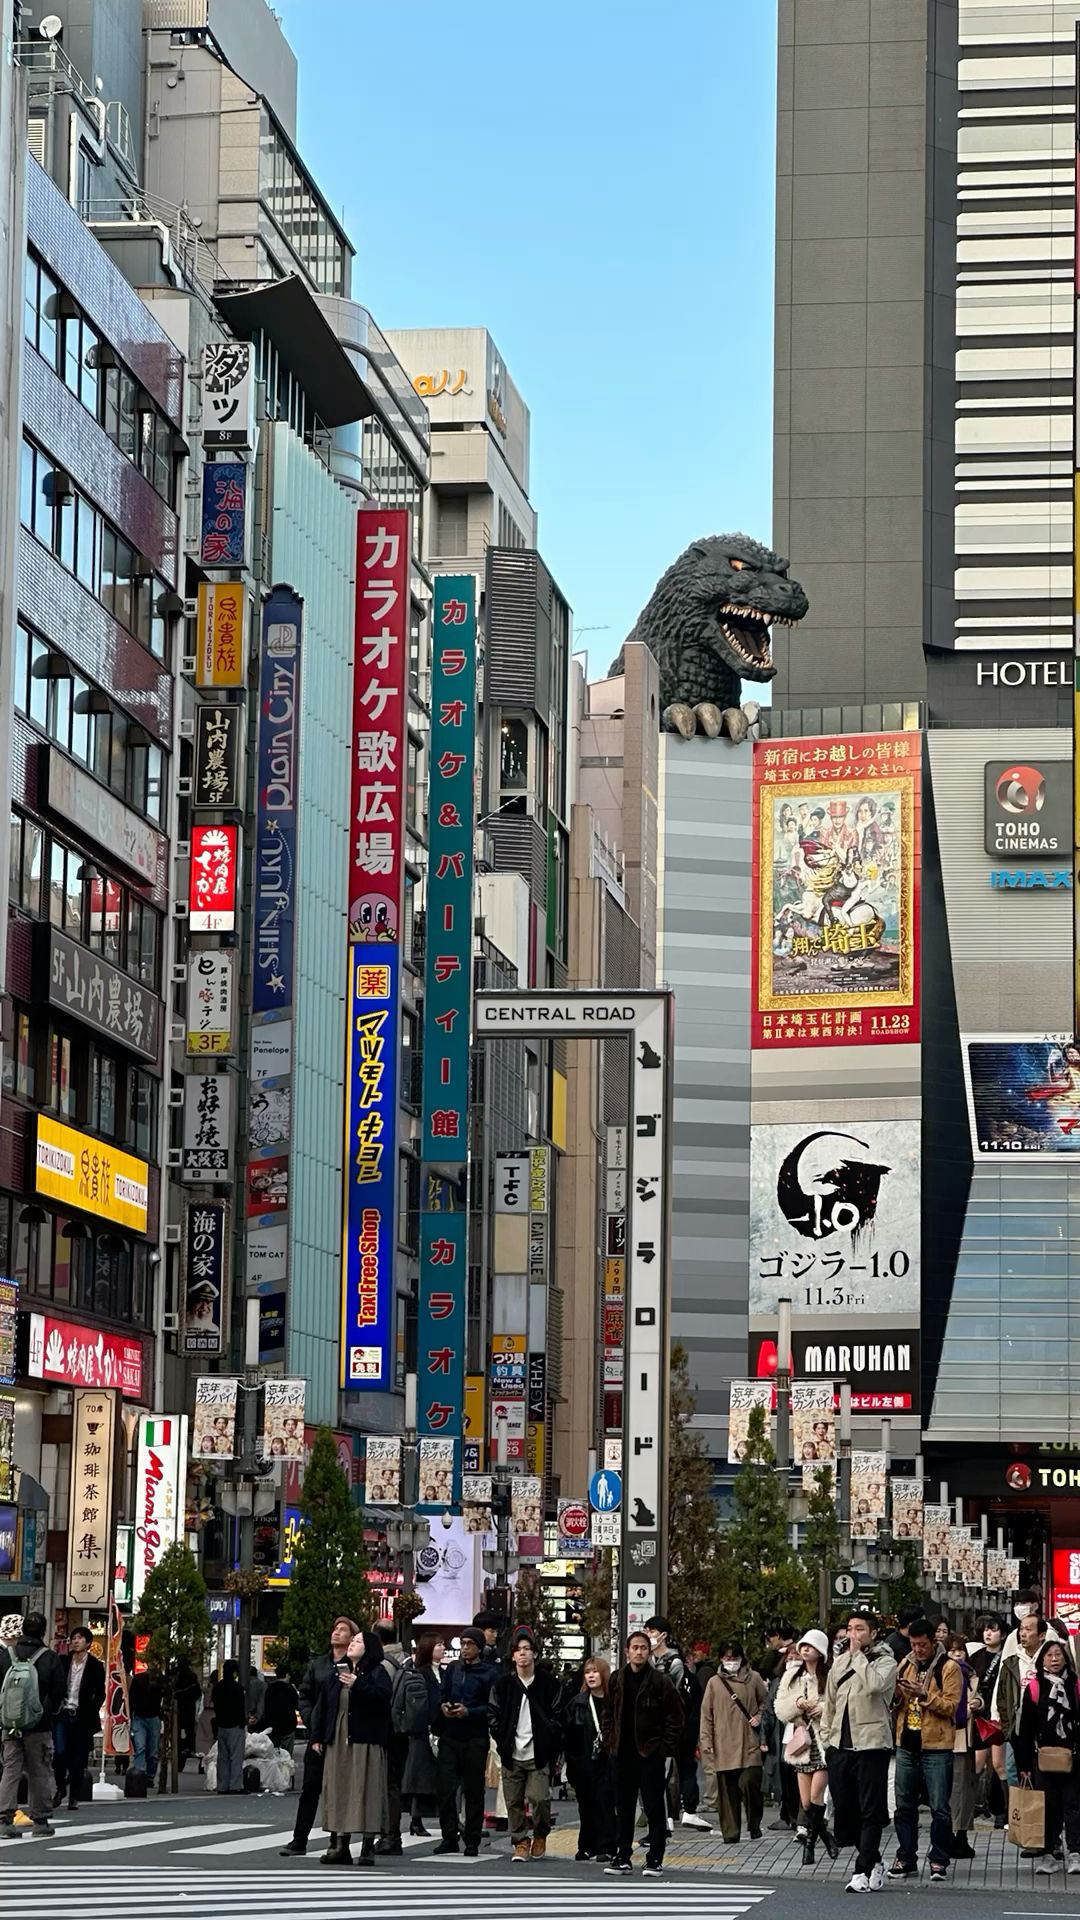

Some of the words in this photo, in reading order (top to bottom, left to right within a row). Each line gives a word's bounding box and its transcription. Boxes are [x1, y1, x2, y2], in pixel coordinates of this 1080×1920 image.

[213, 345, 240, 424] ダーツ
[203, 480, 244, 562] 海の家
[217, 597, 237, 671] 鳥貴族
[977, 661, 1073, 686] HOTEL
[355, 527, 400, 875] カラオケ歌広場
[202, 710, 231, 792] 山内農場
[764, 741, 910, 766] 新宿にお越しの皆様
[208, 792, 223, 803] 5F
[995, 823, 1040, 836] TOHO
[995, 838, 1058, 849] CINEMAS
[213, 848, 232, 894] 焼肉屋
[431, 600, 468, 1137] カラオケ&パーティー館
[991, 869, 1073, 888] IMAX
[258, 838, 289, 968] SHINJUKU
[202, 914, 222, 930] 4F
[792, 920, 881, 956] 翔んで埼玉
[360, 968, 387, 997] 薬
[66, 950, 144, 1046] 山内農場
[486, 1007, 576, 1021] CENTRAL
[583, 1007, 635, 1021] ROAD
[762, 1011, 863, 1027] 日本埼玉化計画
[871, 1015, 910, 1030] 11.23
[199, 1035, 221, 1050] 3F
[871, 1028, 909, 1036] ROADSHOW
[980, 1141, 1022, 1150] 11.10
[192, 1211, 217, 1276] 海の家
[358, 1209, 380, 1255] Shop
[530, 1222, 544, 1275] CAPSULE
[358, 1255, 378, 1295] Free
[759, 1250, 910, 1280] ゴジラ-1.0
[634, 1114, 662, 1456] ゴジラロード
[804, 1287, 844, 1306] 11.3
[846, 1294, 865, 1305] Fri
[357, 1294, 377, 1327] Tax
[426, 1239, 456, 1430] カラオケ
[493, 1353, 525, 1364] つり具
[805, 1344, 911, 1372] MARUHAN
[83, 1442, 101, 1523] 珈琲茶館
[78, 1533, 102, 1560] 集
[81, 1583, 95, 1593] 2F
